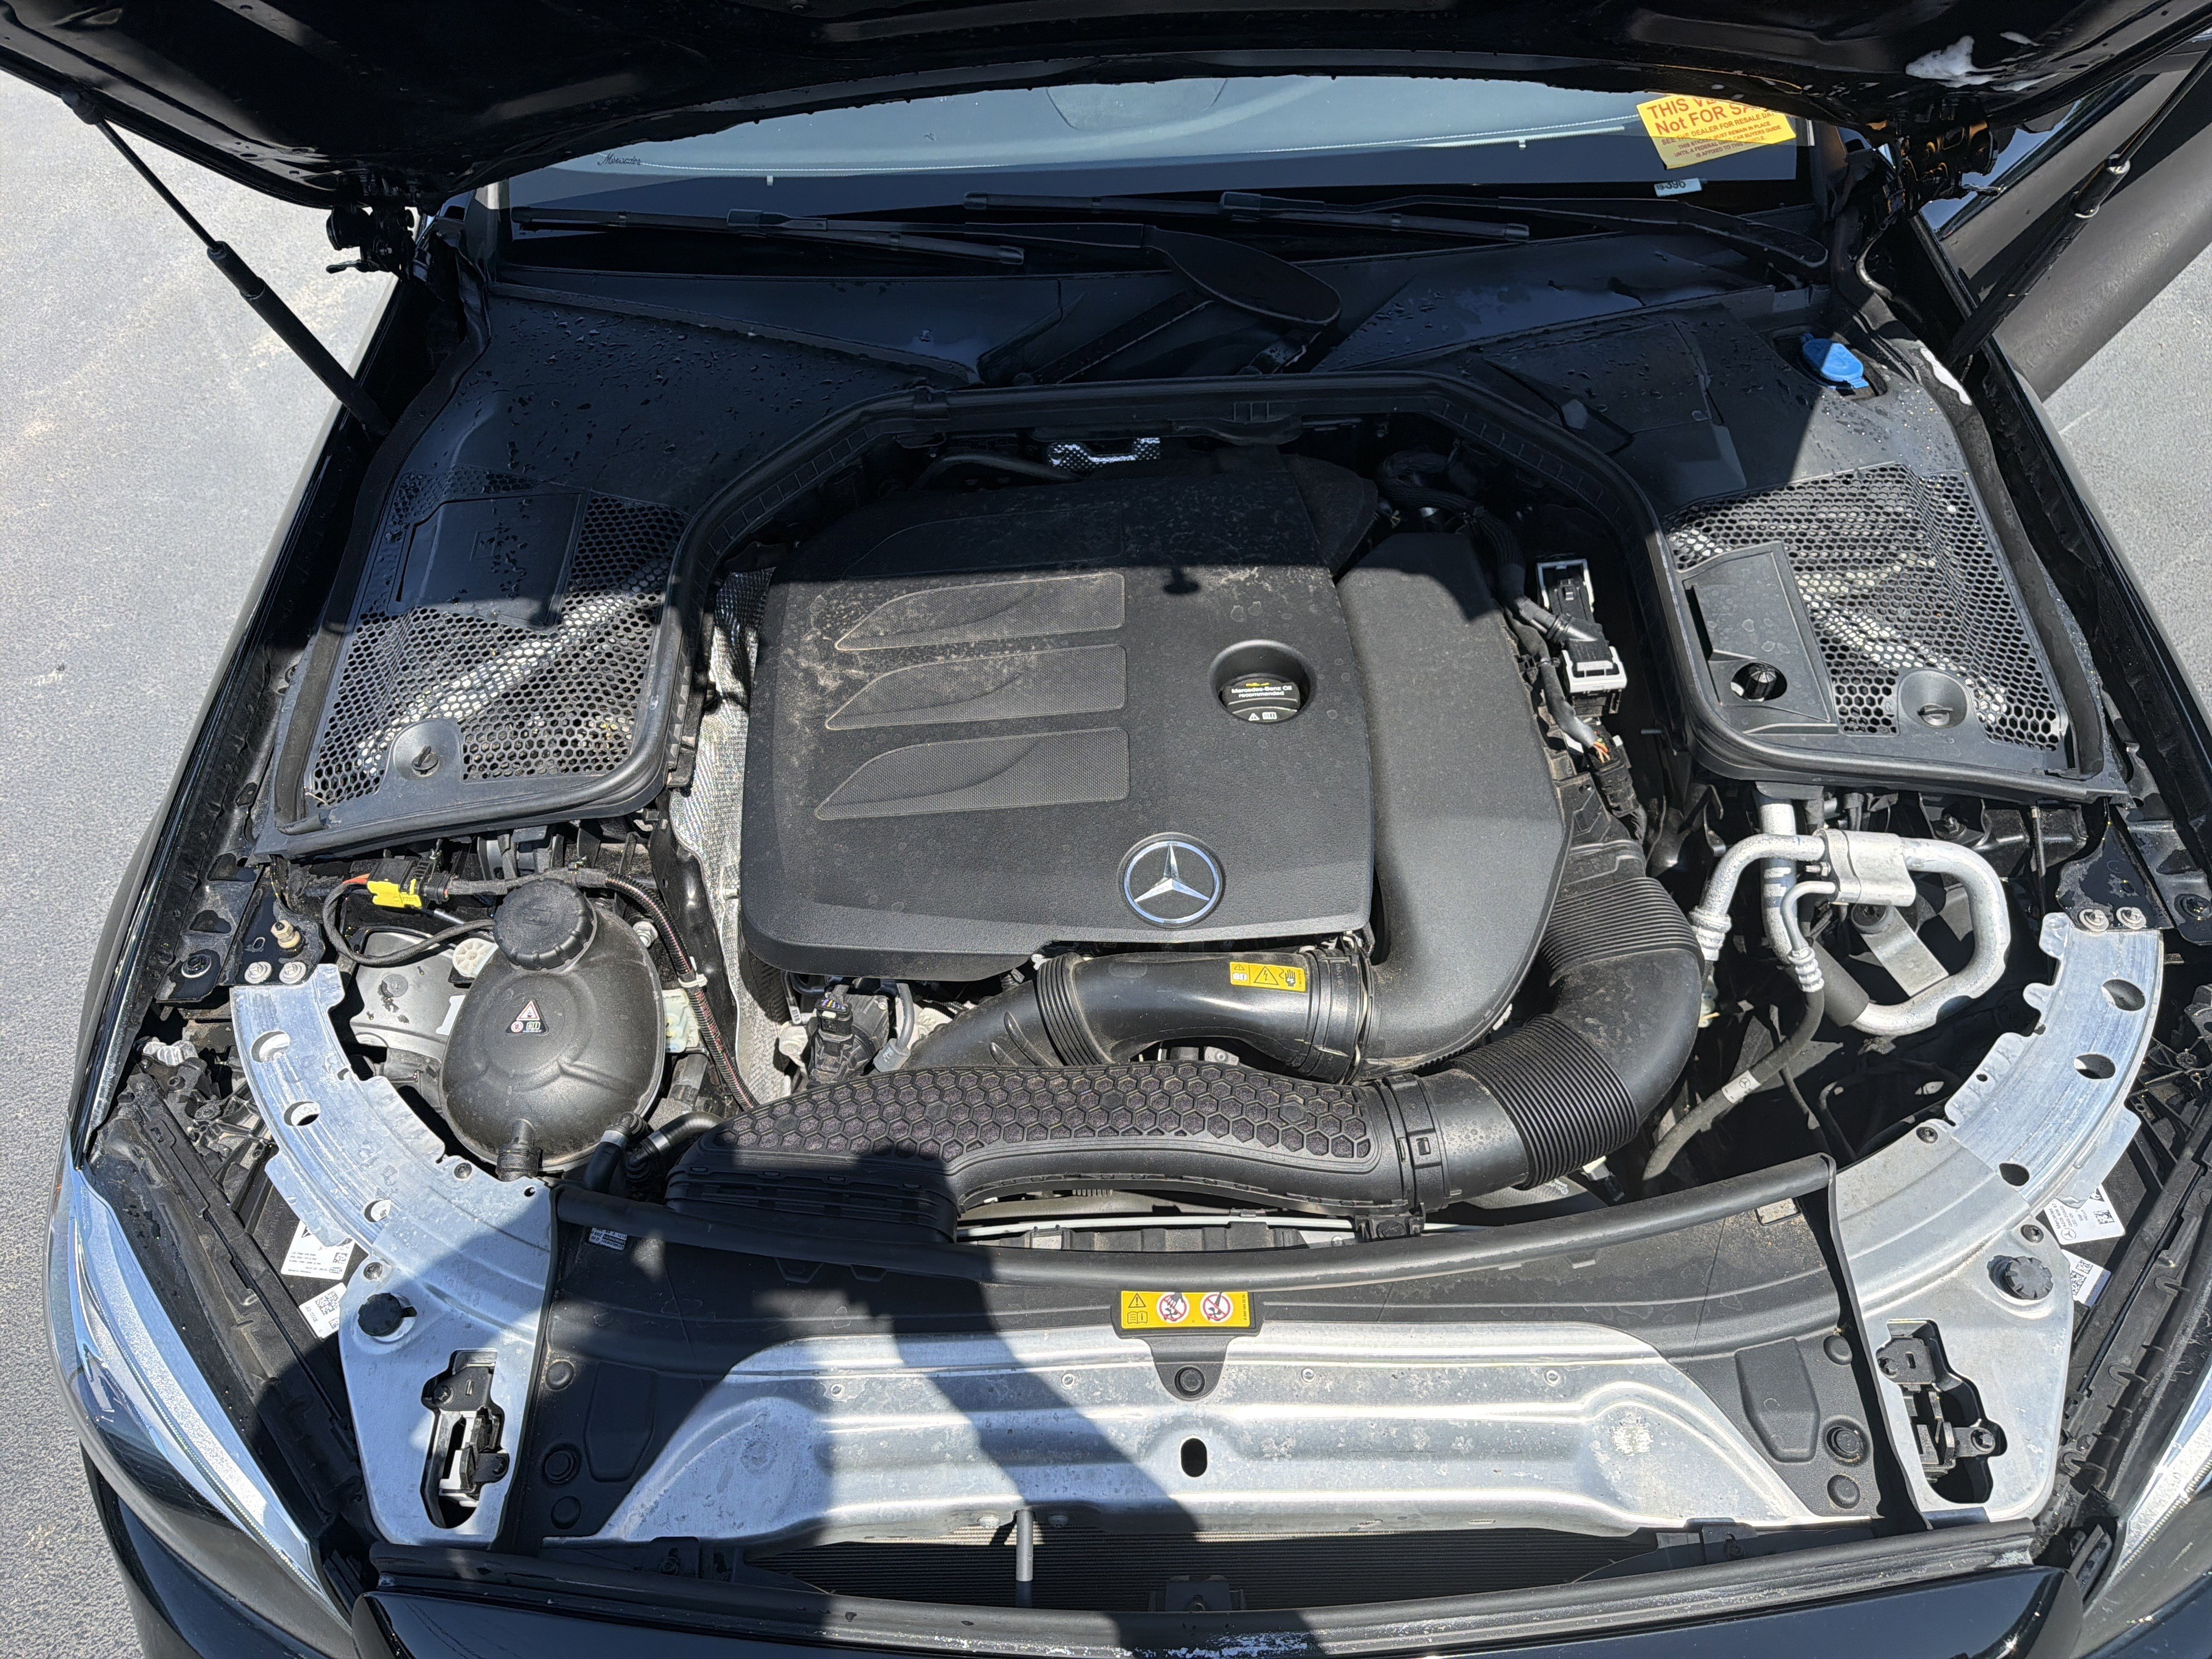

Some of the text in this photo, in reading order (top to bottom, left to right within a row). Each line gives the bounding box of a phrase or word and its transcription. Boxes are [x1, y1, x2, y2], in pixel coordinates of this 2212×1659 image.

[1646, 98, 1689, 119] THIS
[1655, 117, 1688, 136] Not
[1688, 106, 1728, 126] FOR
[1676, 133, 1689, 142] THE
[1691, 125, 1719, 137] DEALER
[1719, 121, 1734, 129] FOR
[1734, 114, 1762, 126] RESALE
[1728, 127, 1748, 136] REMAIN
[1695, 142, 1718, 151] FEDERAL
[1745, 129, 1765, 138] BUYERS
[1765, 125, 1781, 133] GUIDE
[597, 153, 641, 165] Mercedes
[1702, 147, 1723, 156] AFFIXED
